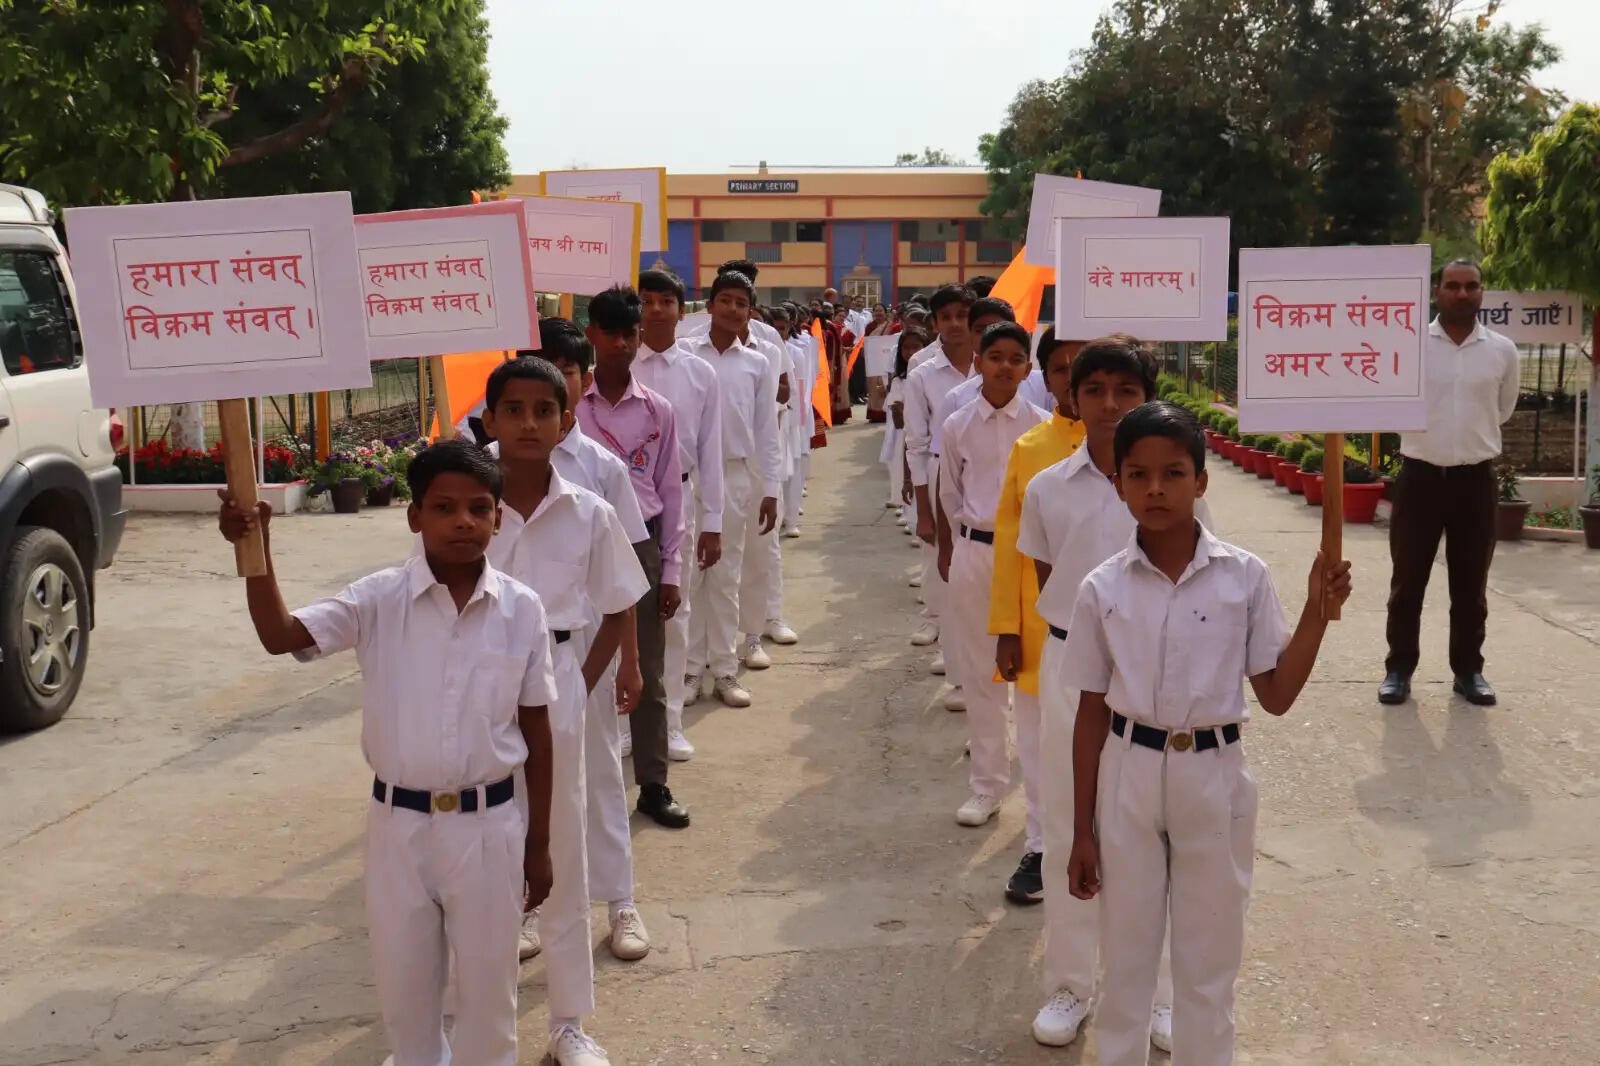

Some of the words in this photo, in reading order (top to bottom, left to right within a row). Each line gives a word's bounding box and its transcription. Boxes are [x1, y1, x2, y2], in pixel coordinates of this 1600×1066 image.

[730, 182, 762, 191] PRIMARY
[765, 182, 796, 191] SECTION
[529, 237, 552, 252] जय
[557, 235, 574, 253] श्री
[127, 259, 220, 296] हमारा
[230, 250, 306, 288] संवत्
[367, 262, 428, 288] हमारा
[434, 254, 487, 281] संवत्
[1088, 265, 1114, 287] वंदे
[1120, 271, 1183, 294] मातरम्
[365, 293, 424, 317] विक्रम
[431, 289, 482, 315] संवत्
[1253, 294, 1336, 328] विक्रम
[1346, 295, 1416, 336] संवत्
[125, 305, 214, 340] विक्रम
[223, 301, 300, 340] संवत्
[1265, 352, 1332, 377] अमर
[1341, 342, 1381, 384] रहे
